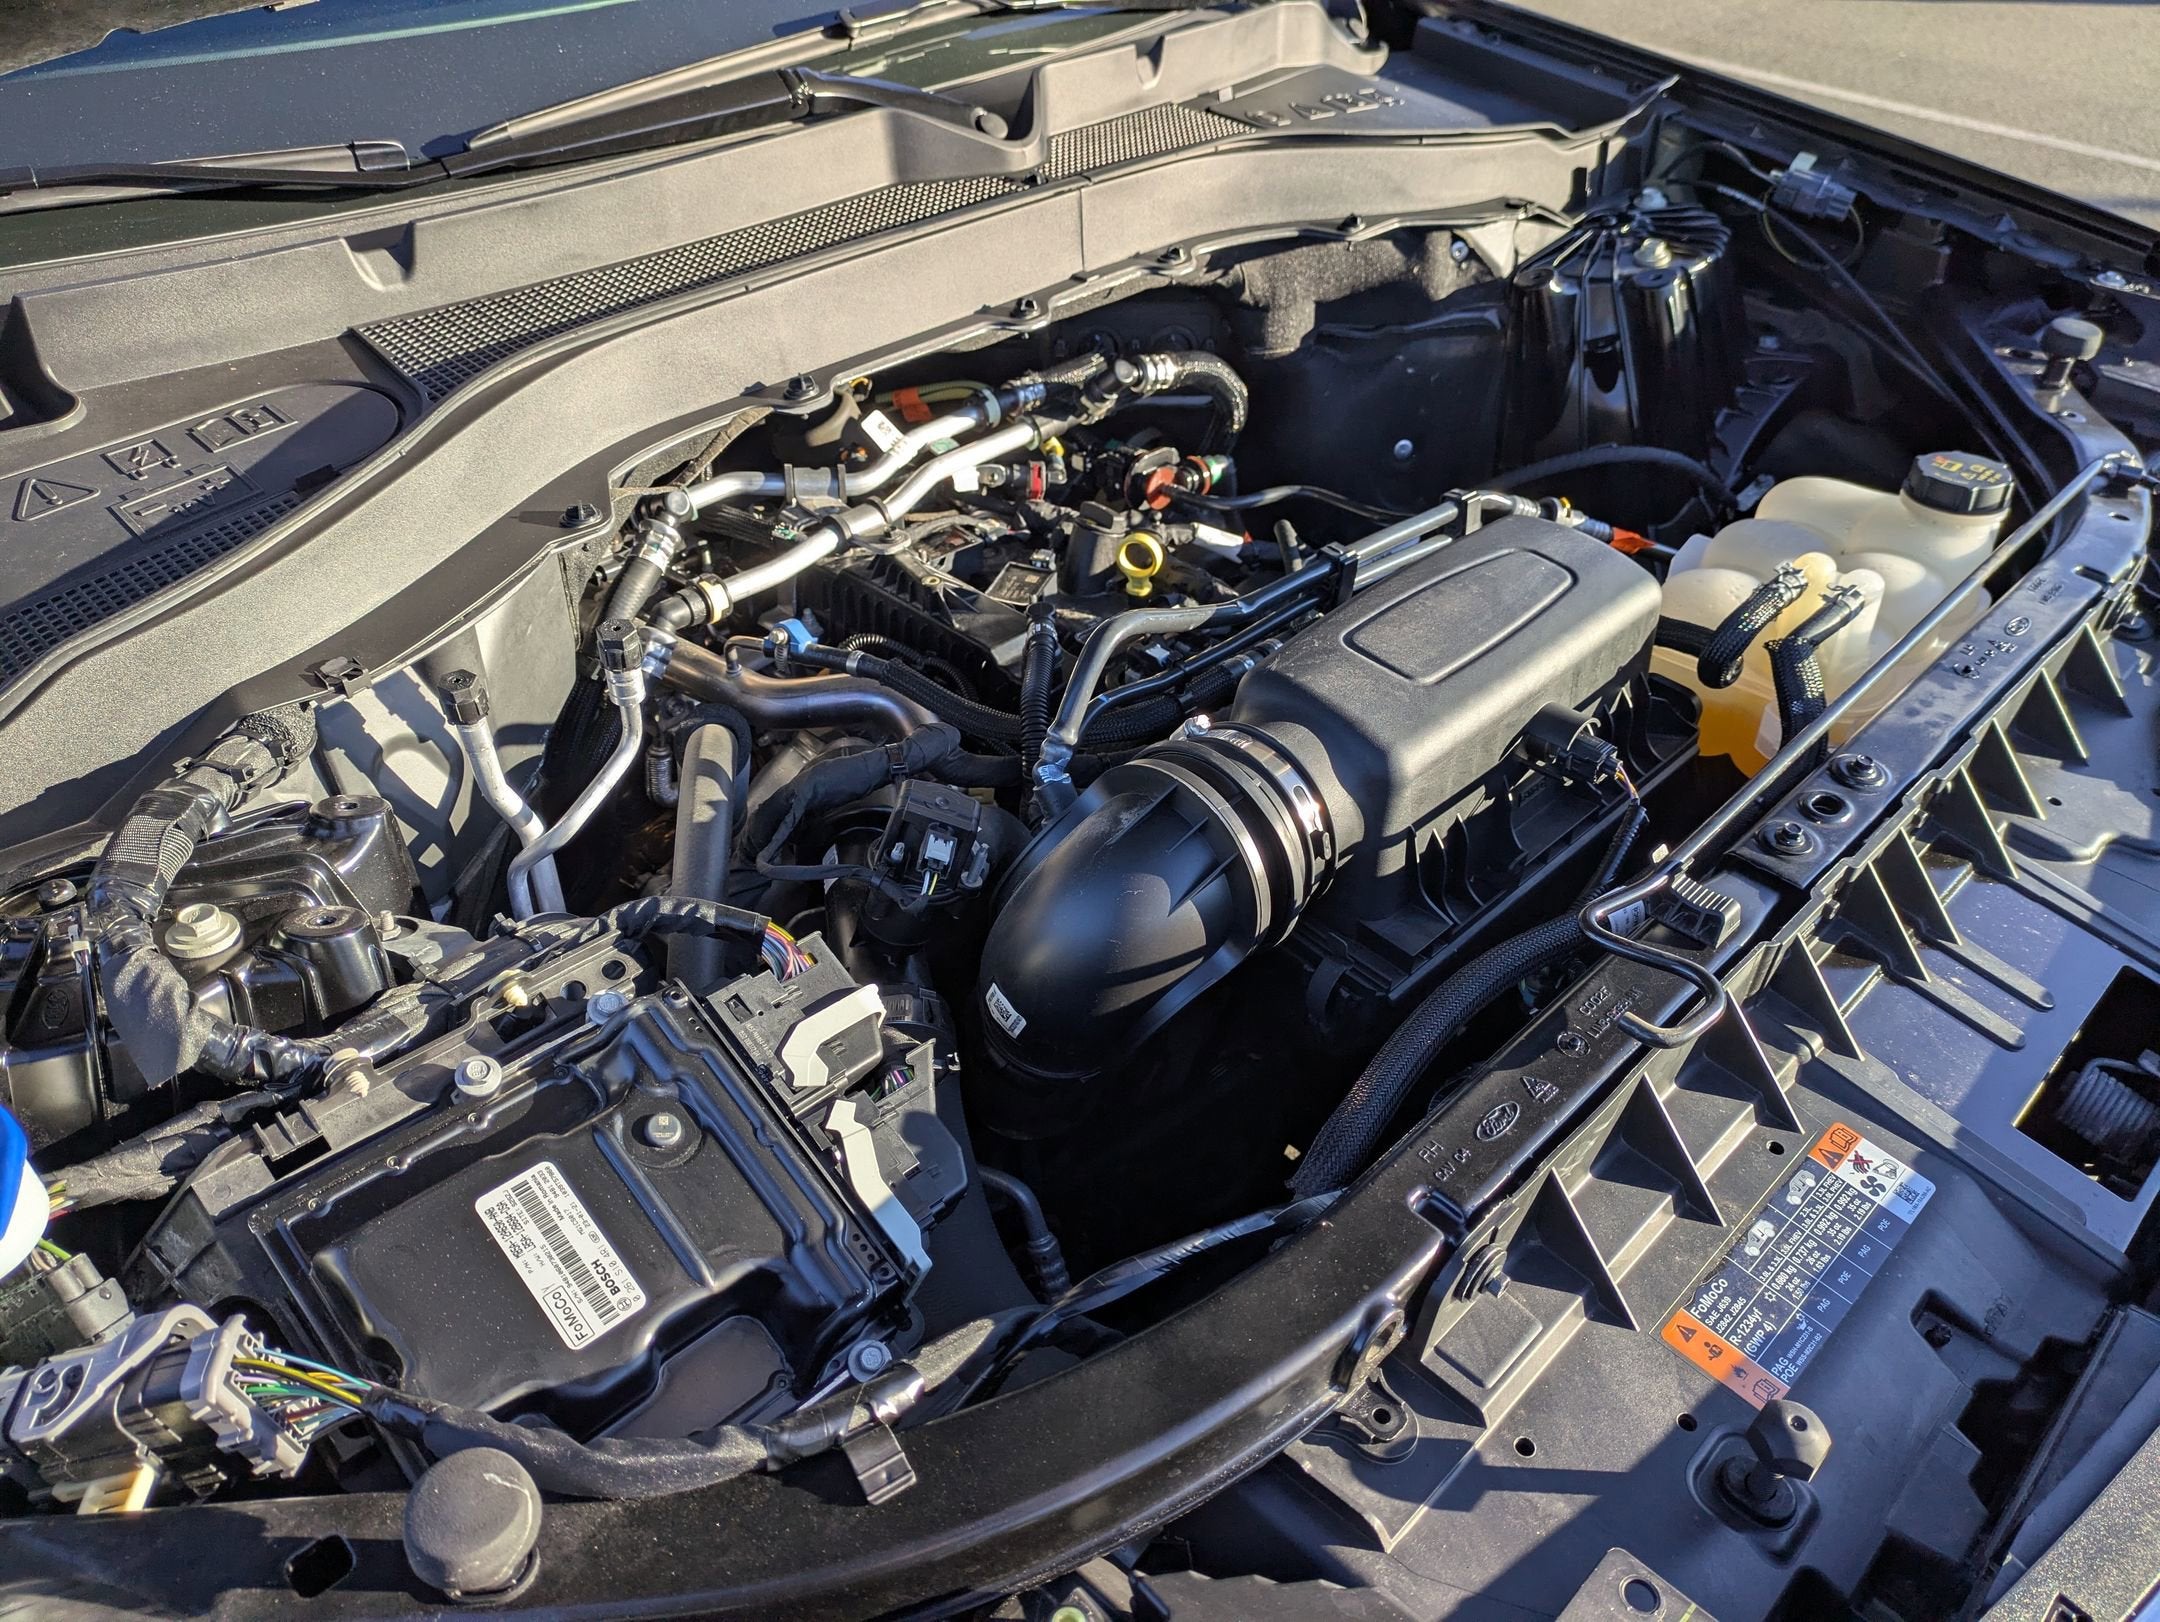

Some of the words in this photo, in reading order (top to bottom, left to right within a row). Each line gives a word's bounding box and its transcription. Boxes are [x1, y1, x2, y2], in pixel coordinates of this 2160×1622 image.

[1479, 1102, 1517, 1139] Ford
[1417, 1137, 1444, 1164] RH
[529, 1173, 549, 1198] Romania
[1833, 1193, 1851, 1211] 0.992
[1844, 1186, 1858, 1198] kg
[1847, 1203, 1856, 1211] 35
[1852, 1198, 1861, 1206] oz
[550, 1203, 565, 1221] Made
[1812, 1217, 1831, 1236] 0.992
[1825, 1210, 1838, 1222] kg
[1826, 1227, 1837, 1237] 35
[1833, 1222, 1841, 1230] oz
[1877, 1218, 1890, 1231] POE
[1791, 1244, 1810, 1264] 0.737
[1803, 1237, 1817, 1250] kg
[1805, 1255, 1816, 1265] 26
[1811, 1250, 1820, 1258] oz
[1857, 1244, 1871, 1258] PAG
[590, 1258, 620, 1296] BOSCH
[1783, 1263, 1797, 1276] kg
[1837, 1270, 1851, 1284] POE
[620, 1277, 635, 1293] 261
[1784, 1281, 1795, 1291] 24
[1791, 1276, 1800, 1285] oz
[1689, 1275, 1729, 1319] FoMoCo
[1816, 1297, 1831, 1313] PAG
[548, 1290, 588, 1341] FoMoCo
[1704, 1309, 1720, 1326] SAE
[1715, 1295, 1732, 1312] J639
[1714, 1313, 1733, 1334] J2842
[1728, 1296, 1747, 1316] J2845
[1728, 1306, 1765, 1347] R-1234yf
[1743, 1328, 1770, 1357] (GWP
[1760, 1319, 1777, 1334] 4)
[1770, 1356, 1789, 1376] PAG
[1780, 1362, 1798, 1383] POE
